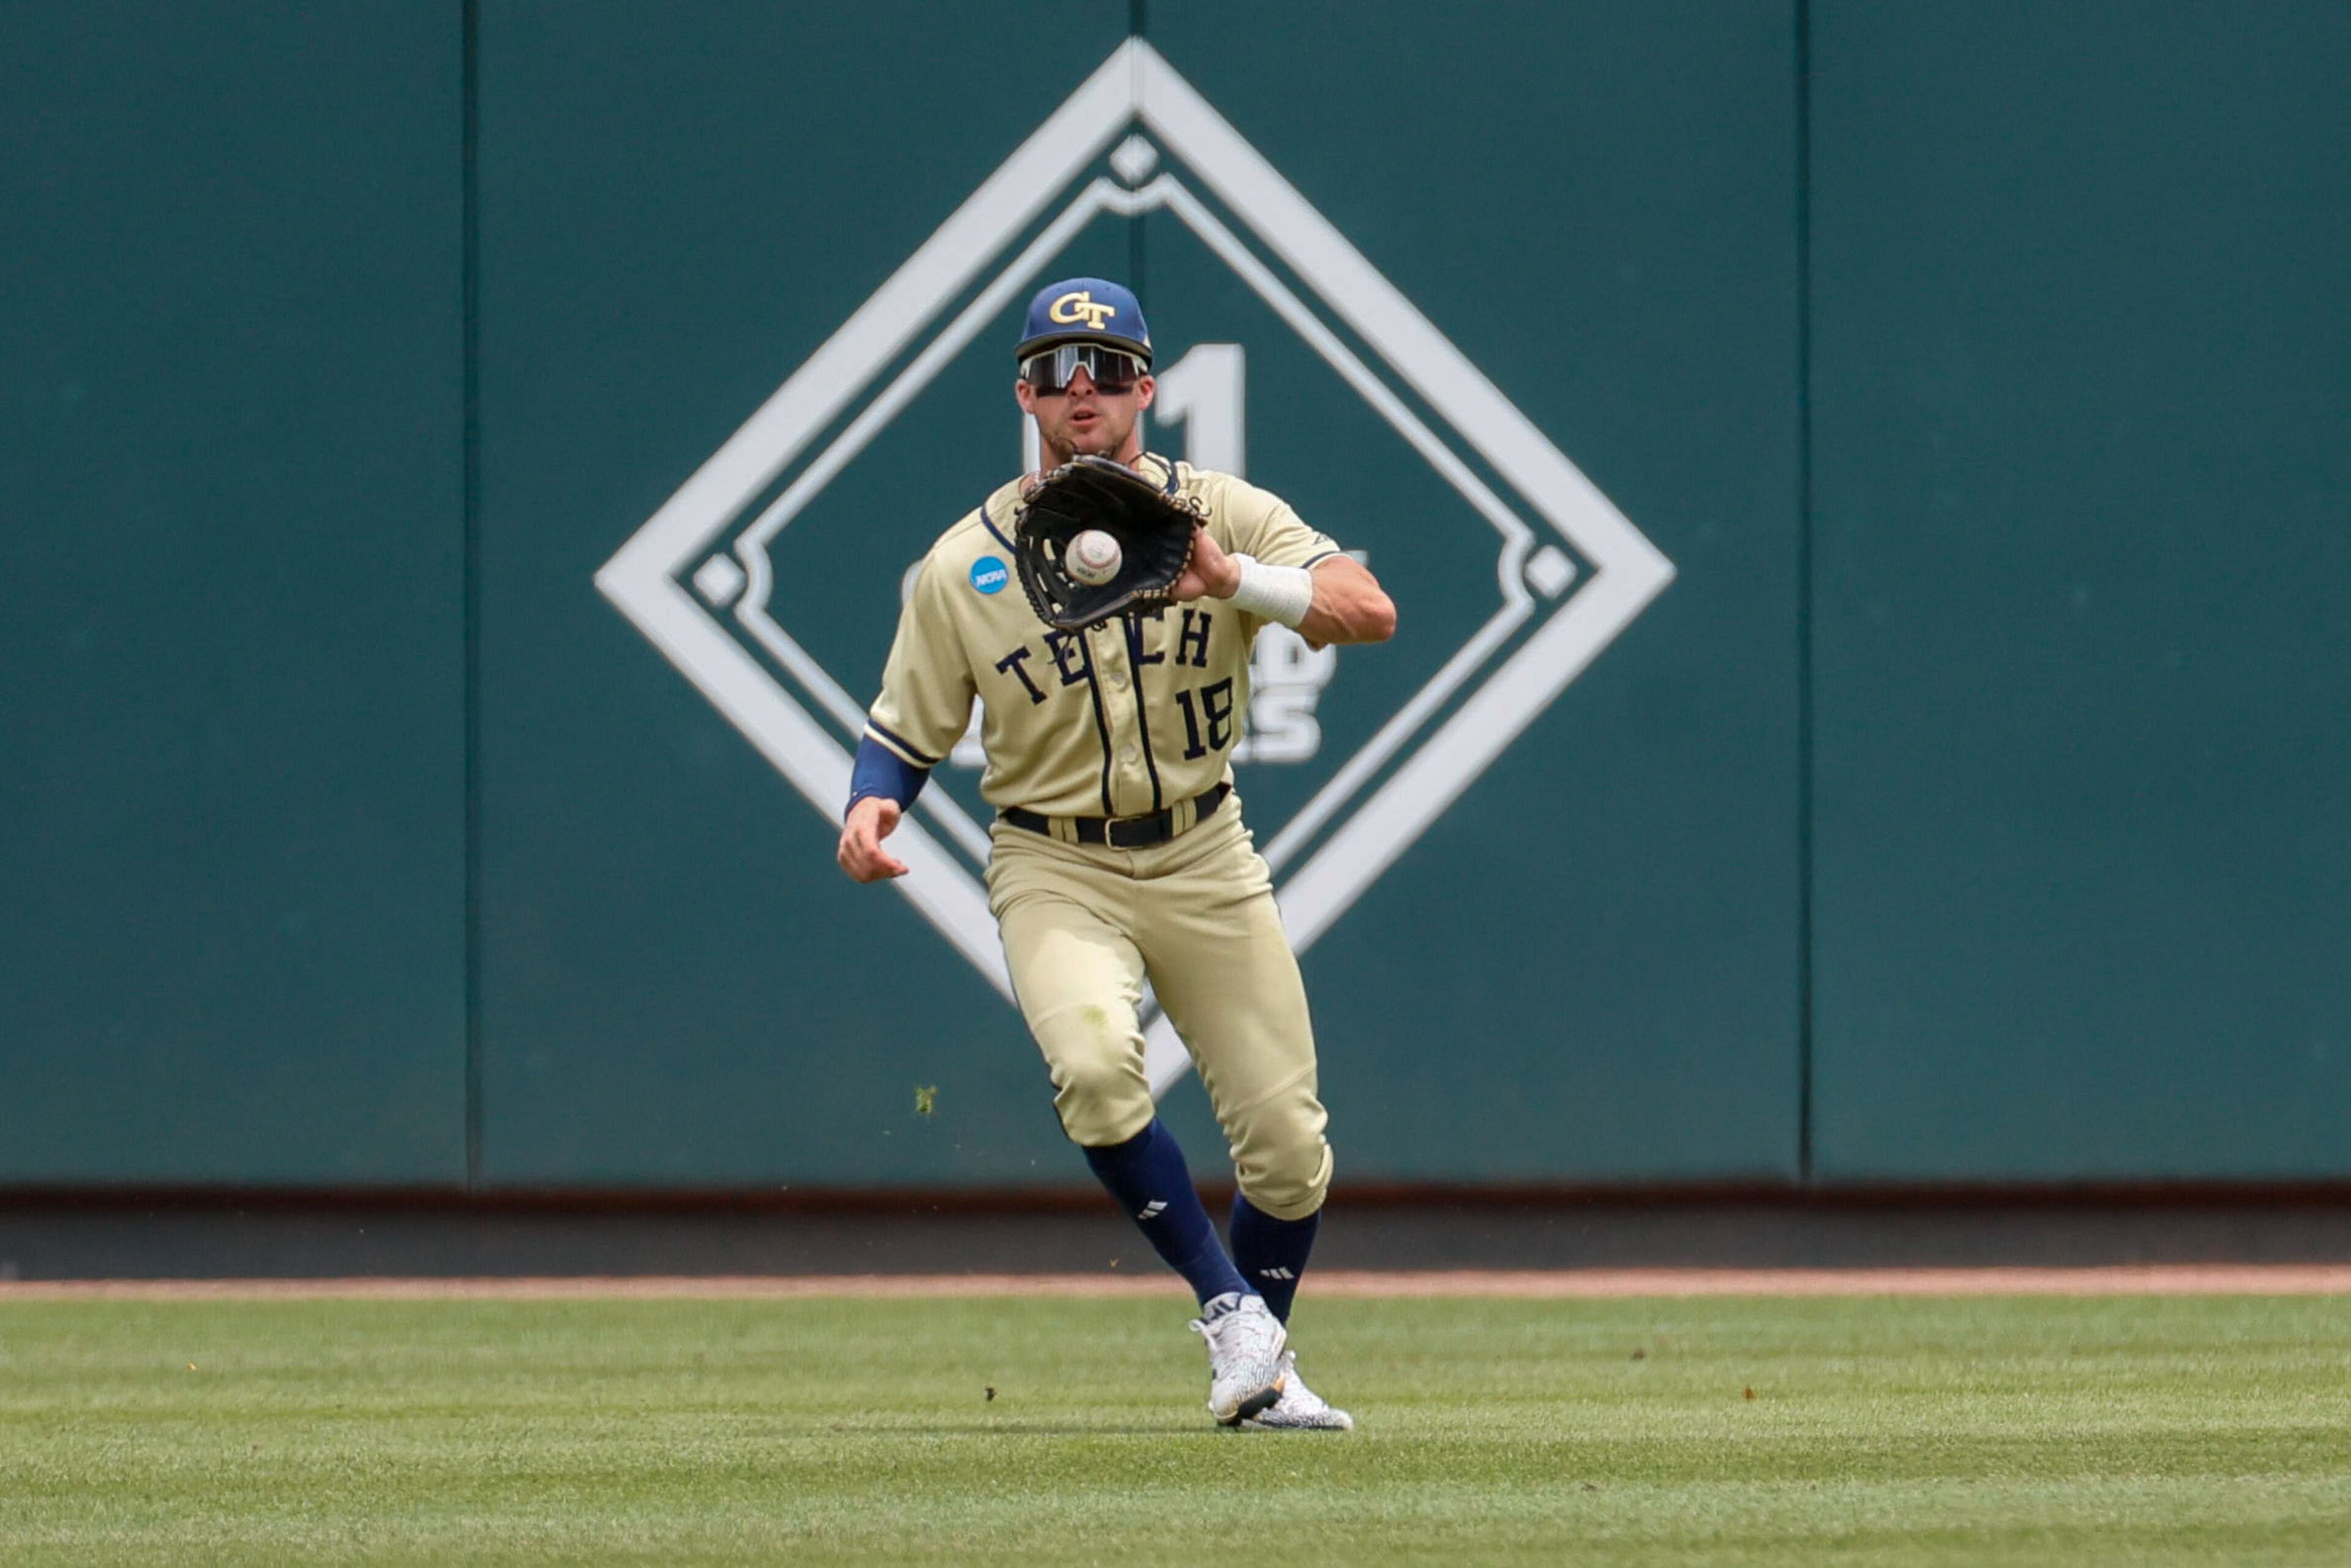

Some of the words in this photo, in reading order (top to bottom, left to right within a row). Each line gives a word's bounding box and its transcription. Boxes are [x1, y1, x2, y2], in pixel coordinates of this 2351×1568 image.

[1049, 290, 1115, 330] GT
[995, 608, 1212, 705] TECH
[1175, 676, 1232, 761] 18
